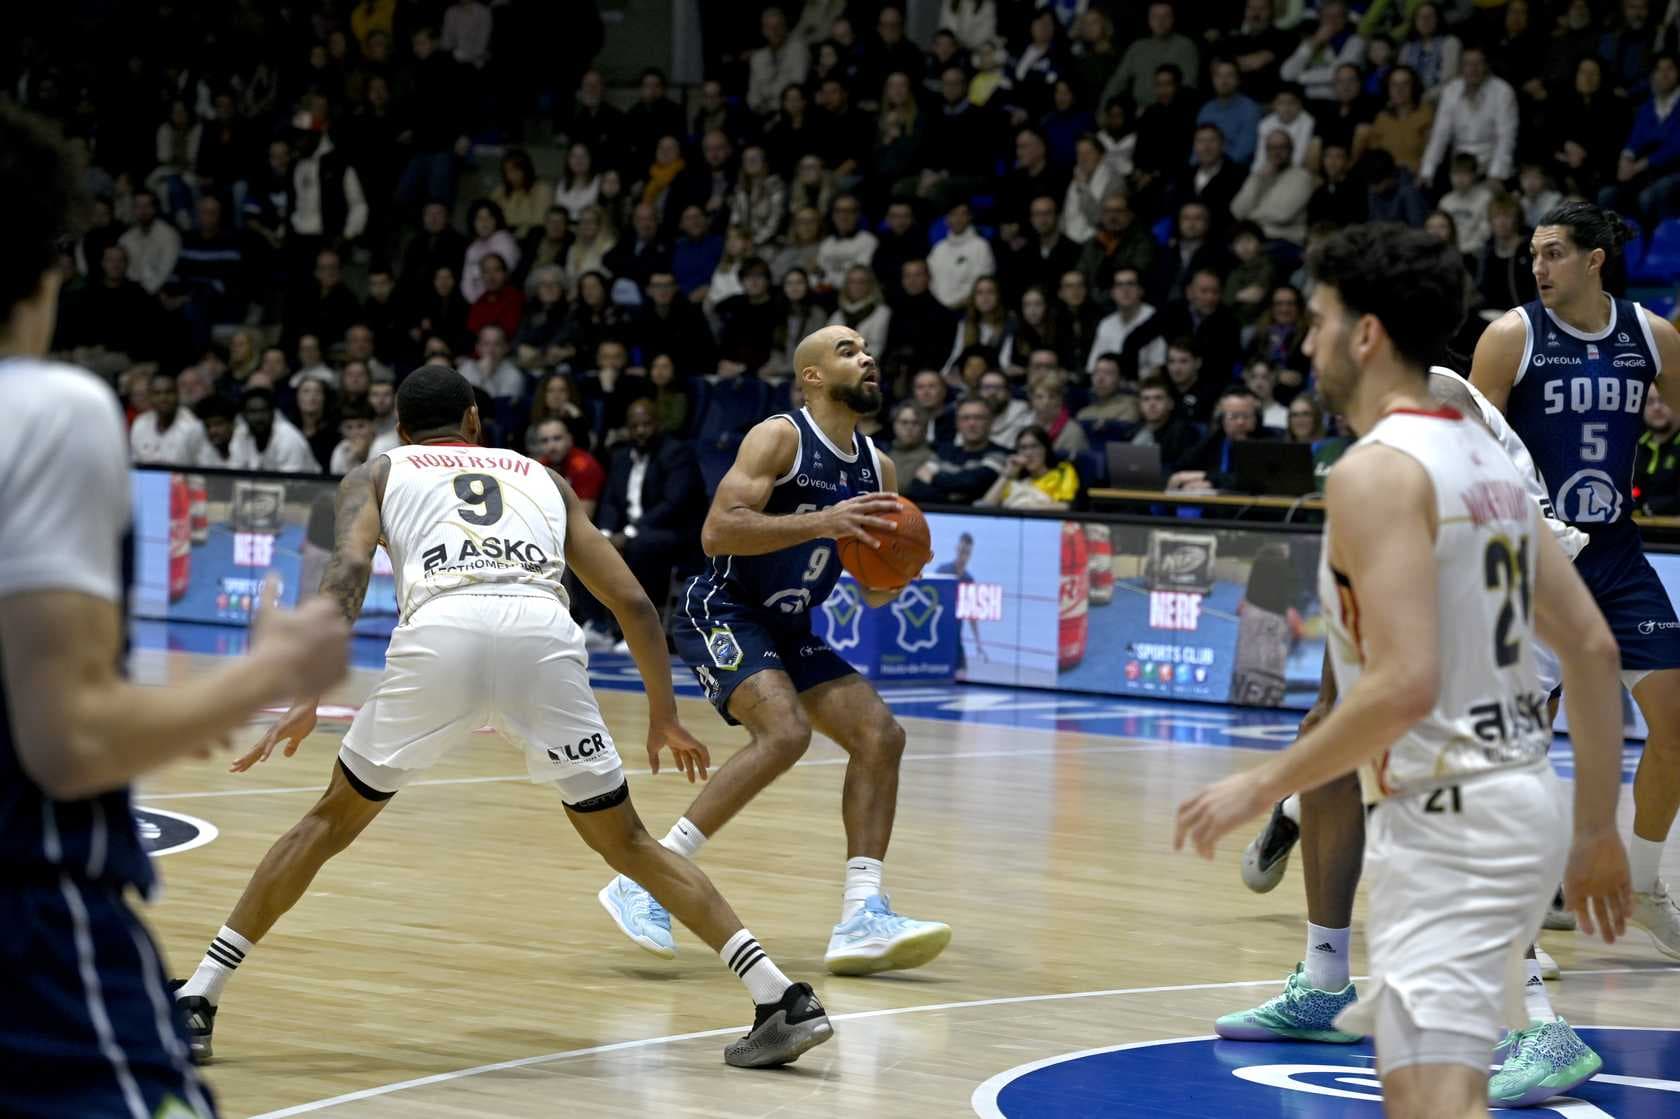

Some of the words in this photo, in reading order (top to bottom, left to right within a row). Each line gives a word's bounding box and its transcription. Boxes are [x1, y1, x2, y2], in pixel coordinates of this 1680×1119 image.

[1547, 357, 1582, 365] VEOLIA
[1544, 377, 1644, 415] SQBB
[1581, 423, 1608, 462] 5
[408, 453, 530, 476] ROBERSON
[453, 472, 503, 526] 9
[810, 478, 837, 492] VEOLIA
[459, 537, 548, 564] ASKO
[802, 546, 831, 581] 9
[1149, 591, 1203, 630] NERF
[1484, 534, 1530, 668] 21
[564, 733, 605, 761] LCR
[1424, 786, 1461, 813] 21
